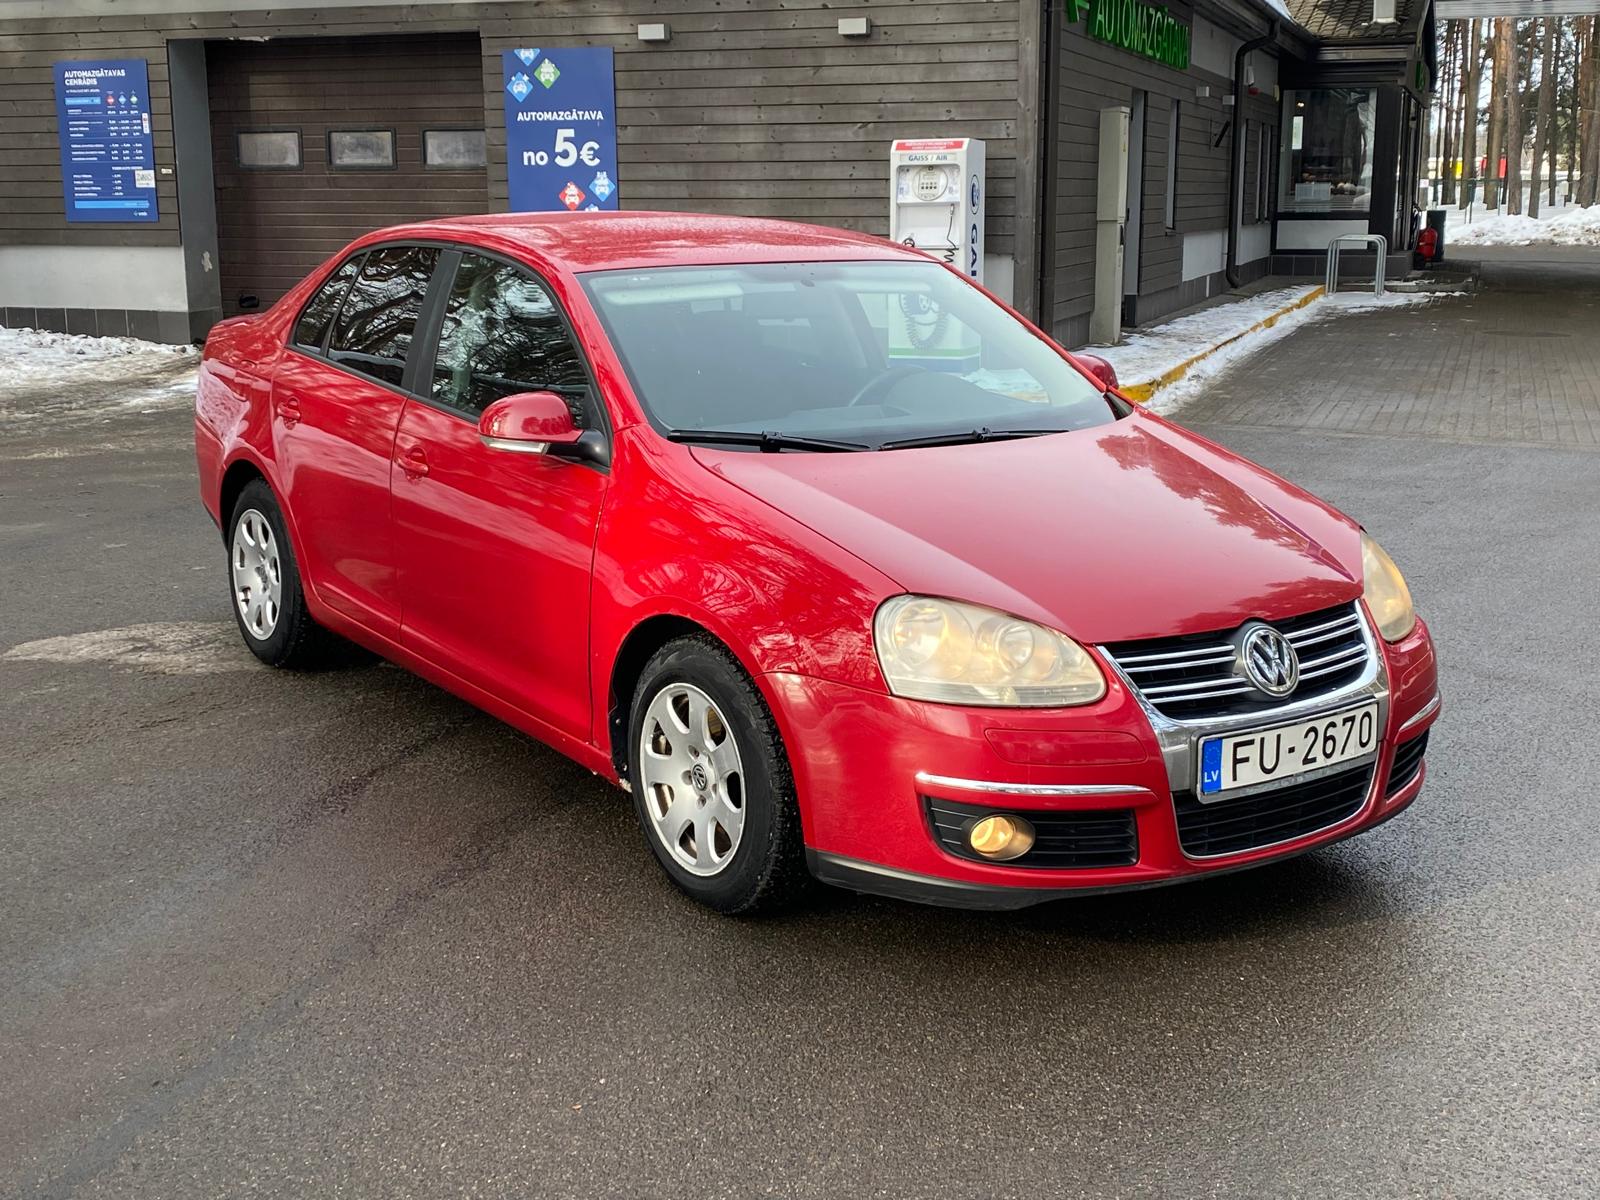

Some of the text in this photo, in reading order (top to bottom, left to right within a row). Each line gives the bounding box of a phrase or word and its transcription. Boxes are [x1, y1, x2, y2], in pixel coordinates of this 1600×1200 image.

[64, 68, 126, 79] AUTOMAZGĀTAVAS
[64, 76, 98, 86] CENRĀDIS
[516, 109, 604, 121] AUTOMAZGĀTAVA
[523, 128, 601, 167] no 5€
[1231, 710, 1373, 782] FU-2670
[1204, 769, 1219, 784] LV
